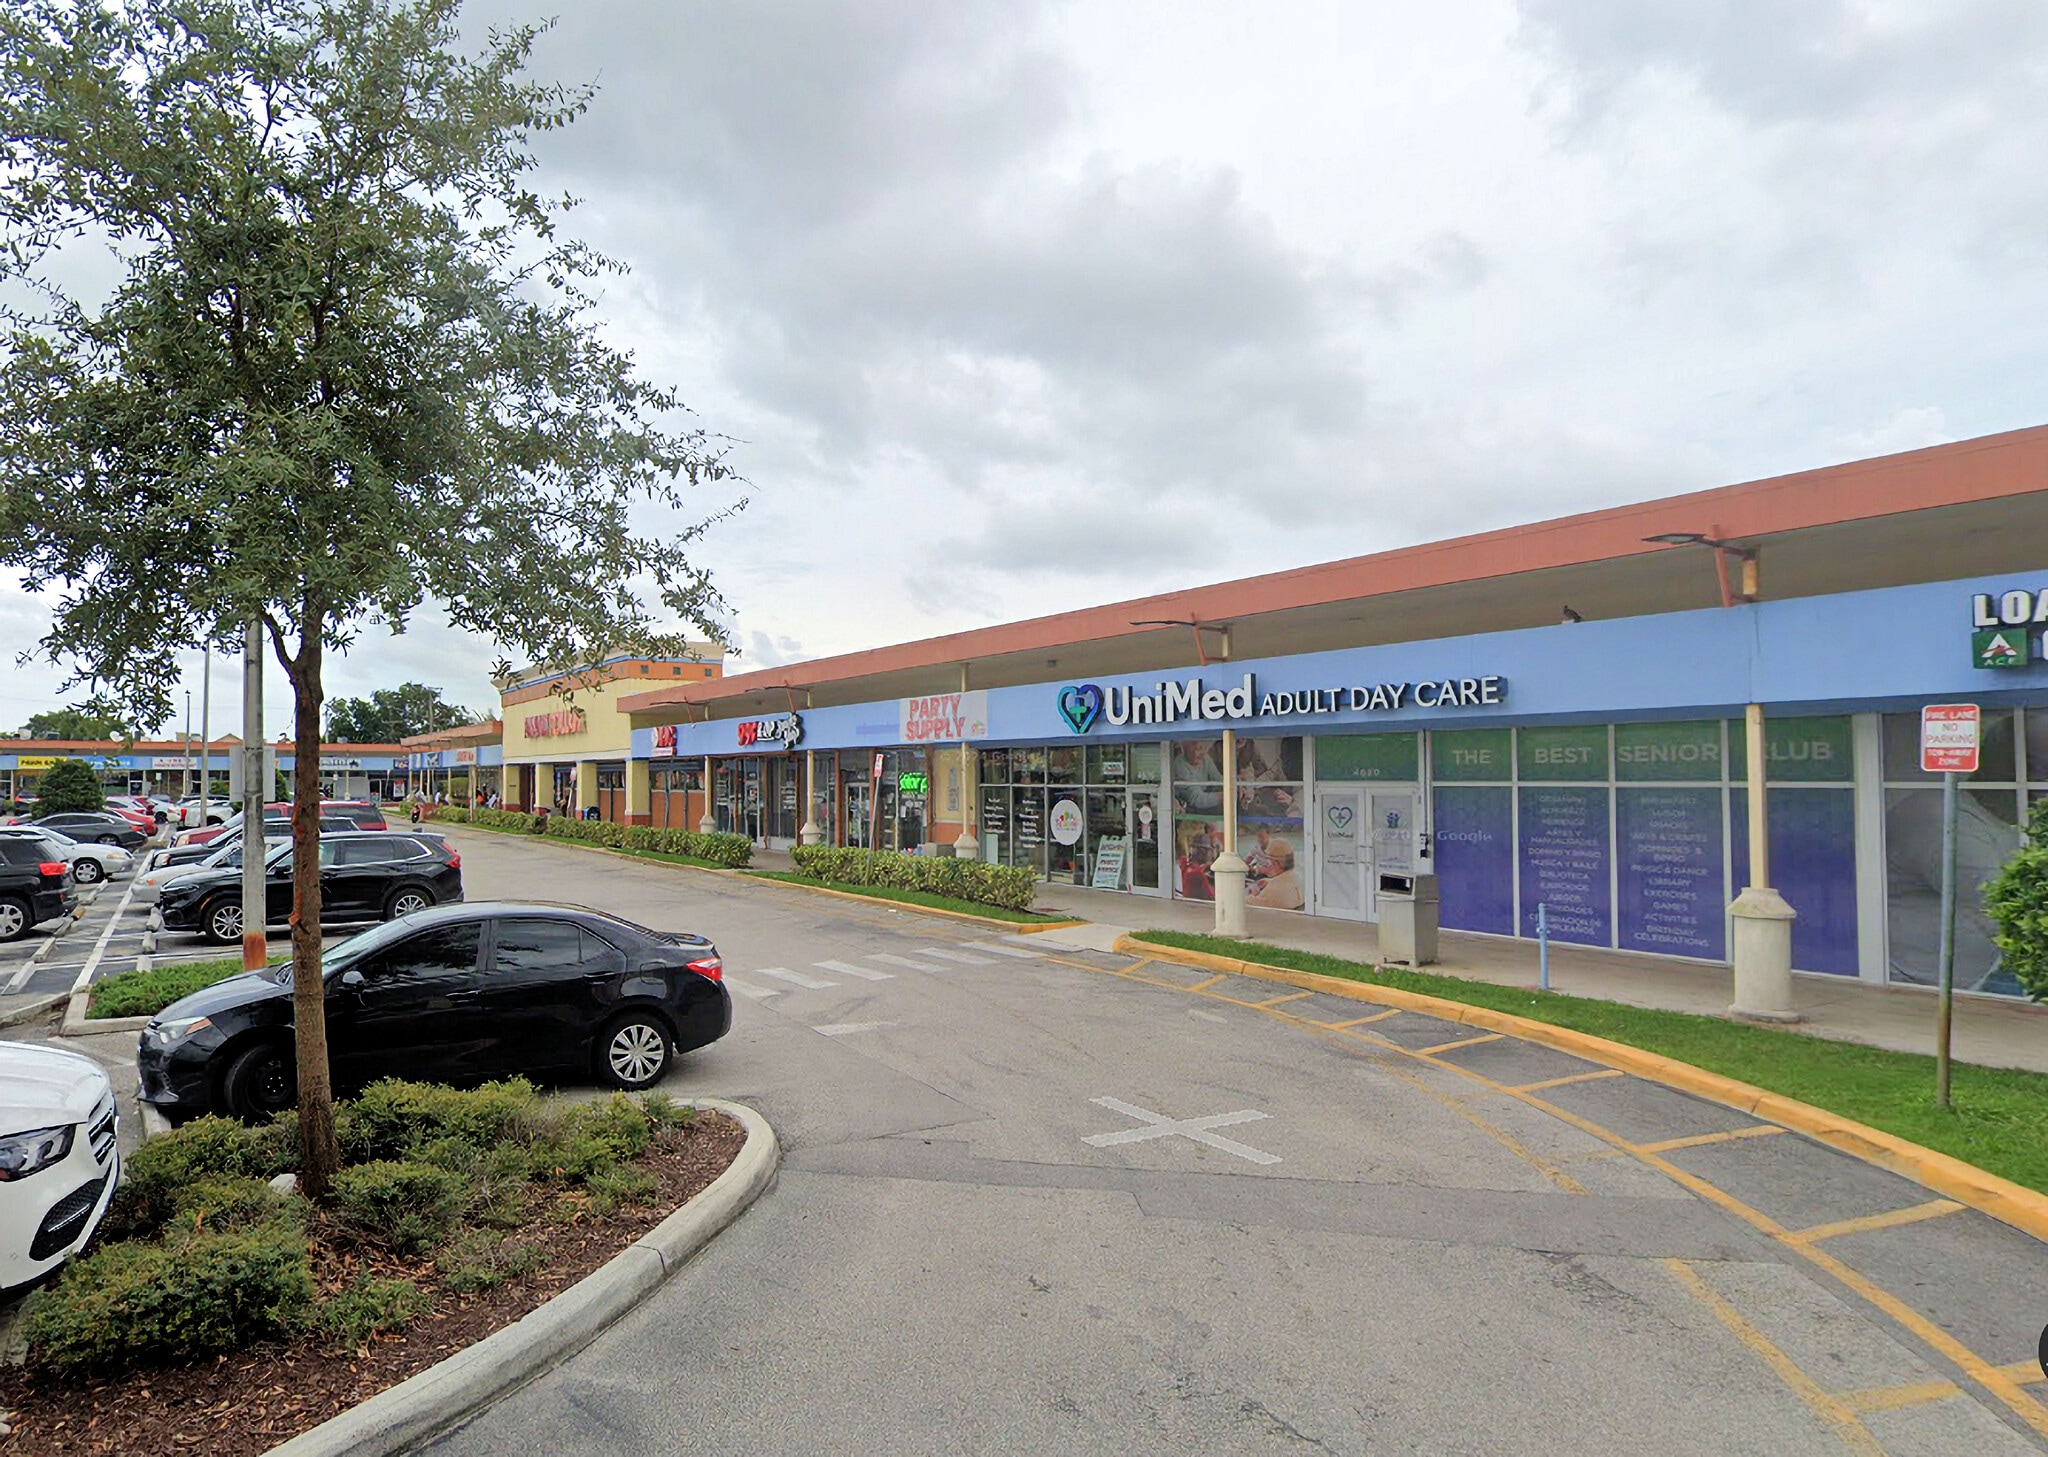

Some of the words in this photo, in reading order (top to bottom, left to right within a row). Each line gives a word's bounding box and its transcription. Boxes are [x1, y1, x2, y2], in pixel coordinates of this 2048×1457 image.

[909, 694, 961, 720] PARTY
[1105, 673, 1254, 726] UniMed
[1260, 687, 1343, 717] ADULT
[1350, 683, 1407, 711] DAY
[1414, 675, 1500, 707] CARE
[1950, 709, 1977, 719] LANE
[905, 716, 965, 741] SUPPLY
[1942, 722, 1958, 732] NO
[1926, 734, 1974, 744] PARKING
[1452, 749, 1492, 765] THE
[1535, 746, 1593, 764] BEST
[1618, 743, 1719, 763] SENIOR
[1762, 740, 1832, 761] LUB
[1653, 901, 1688, 911] GAMES
